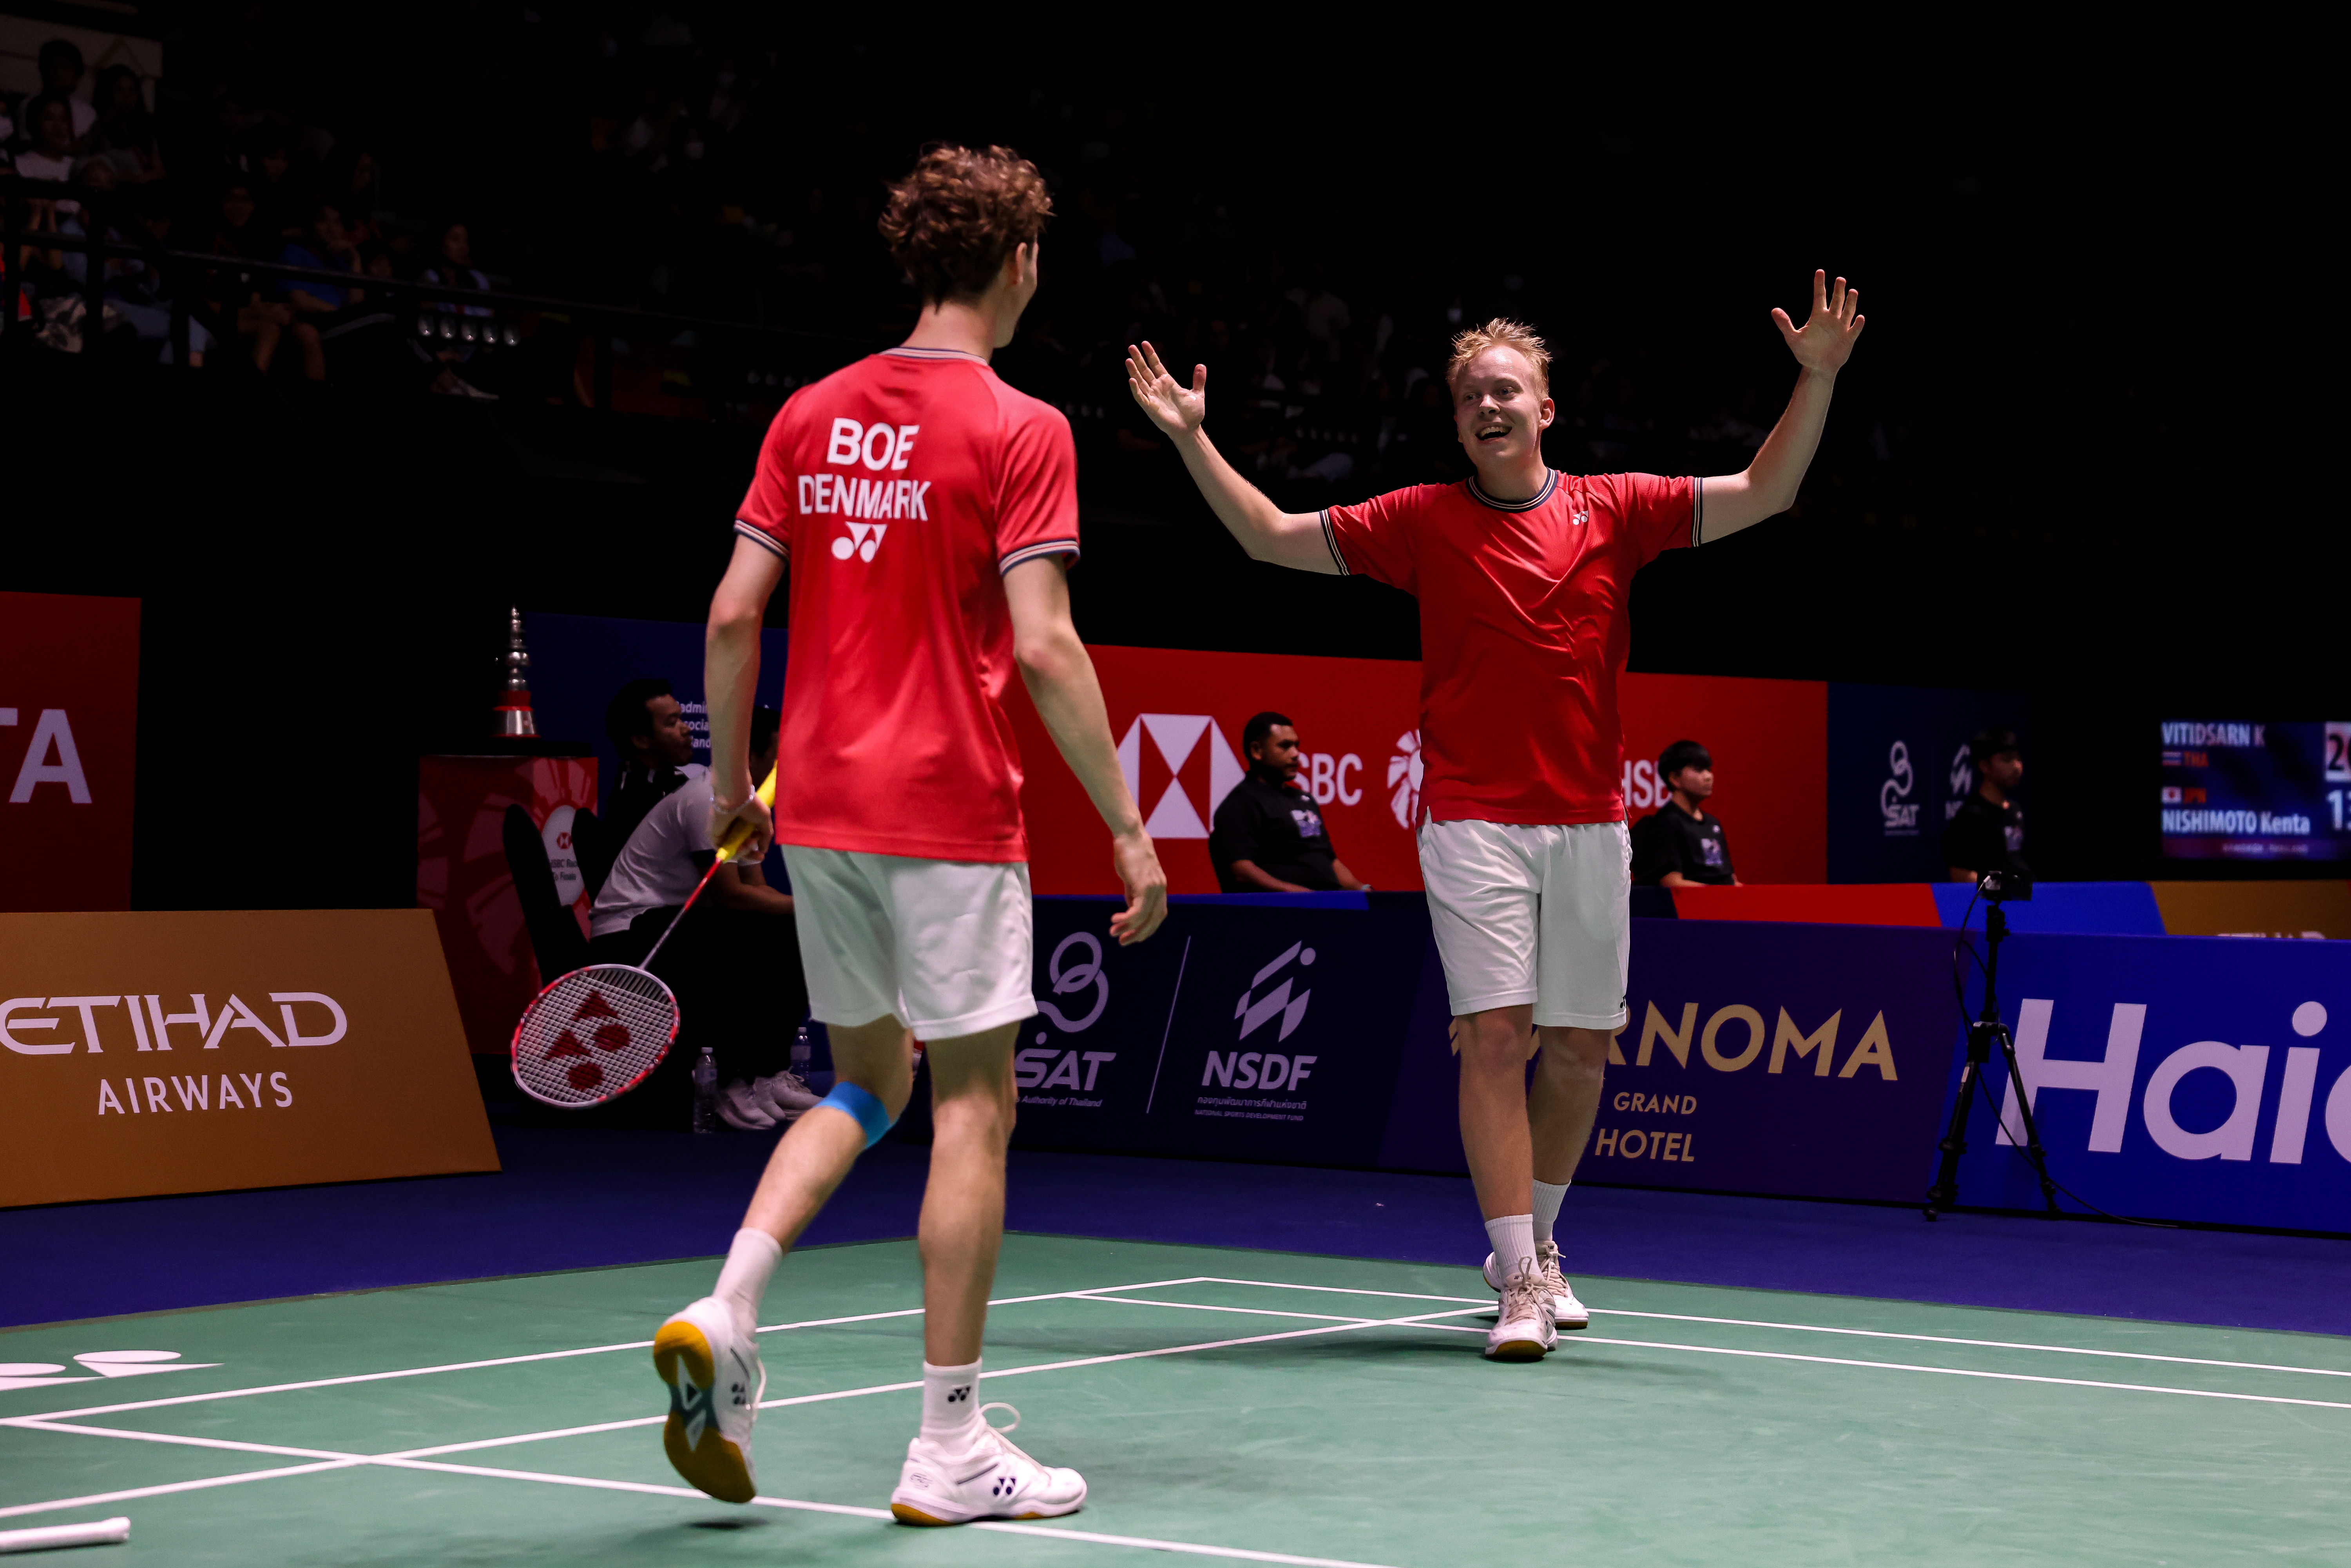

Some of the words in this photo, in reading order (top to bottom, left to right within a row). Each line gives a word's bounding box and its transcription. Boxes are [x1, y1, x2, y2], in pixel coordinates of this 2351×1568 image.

[827, 418, 920, 471] BOE
[798, 473, 931, 521] DENMARK
[0, 708, 92, 803] A
[2328, 733, 2351, 770] 2
[2162, 809, 2257, 834] NISHIMOTO
[2260, 811, 2311, 835] Kenta
[0, 992, 348, 1055] ETIHAD
[1014, 1048, 1117, 1091] SAT
[1201, 1050, 1318, 1091] NSDF
[1995, 998, 2351, 1165] Hai
[98, 1071, 293, 1115] AIRWAYS
[1613, 1092, 1697, 1114] GRAND
[1594, 1129, 1695, 1162] HOTEL
